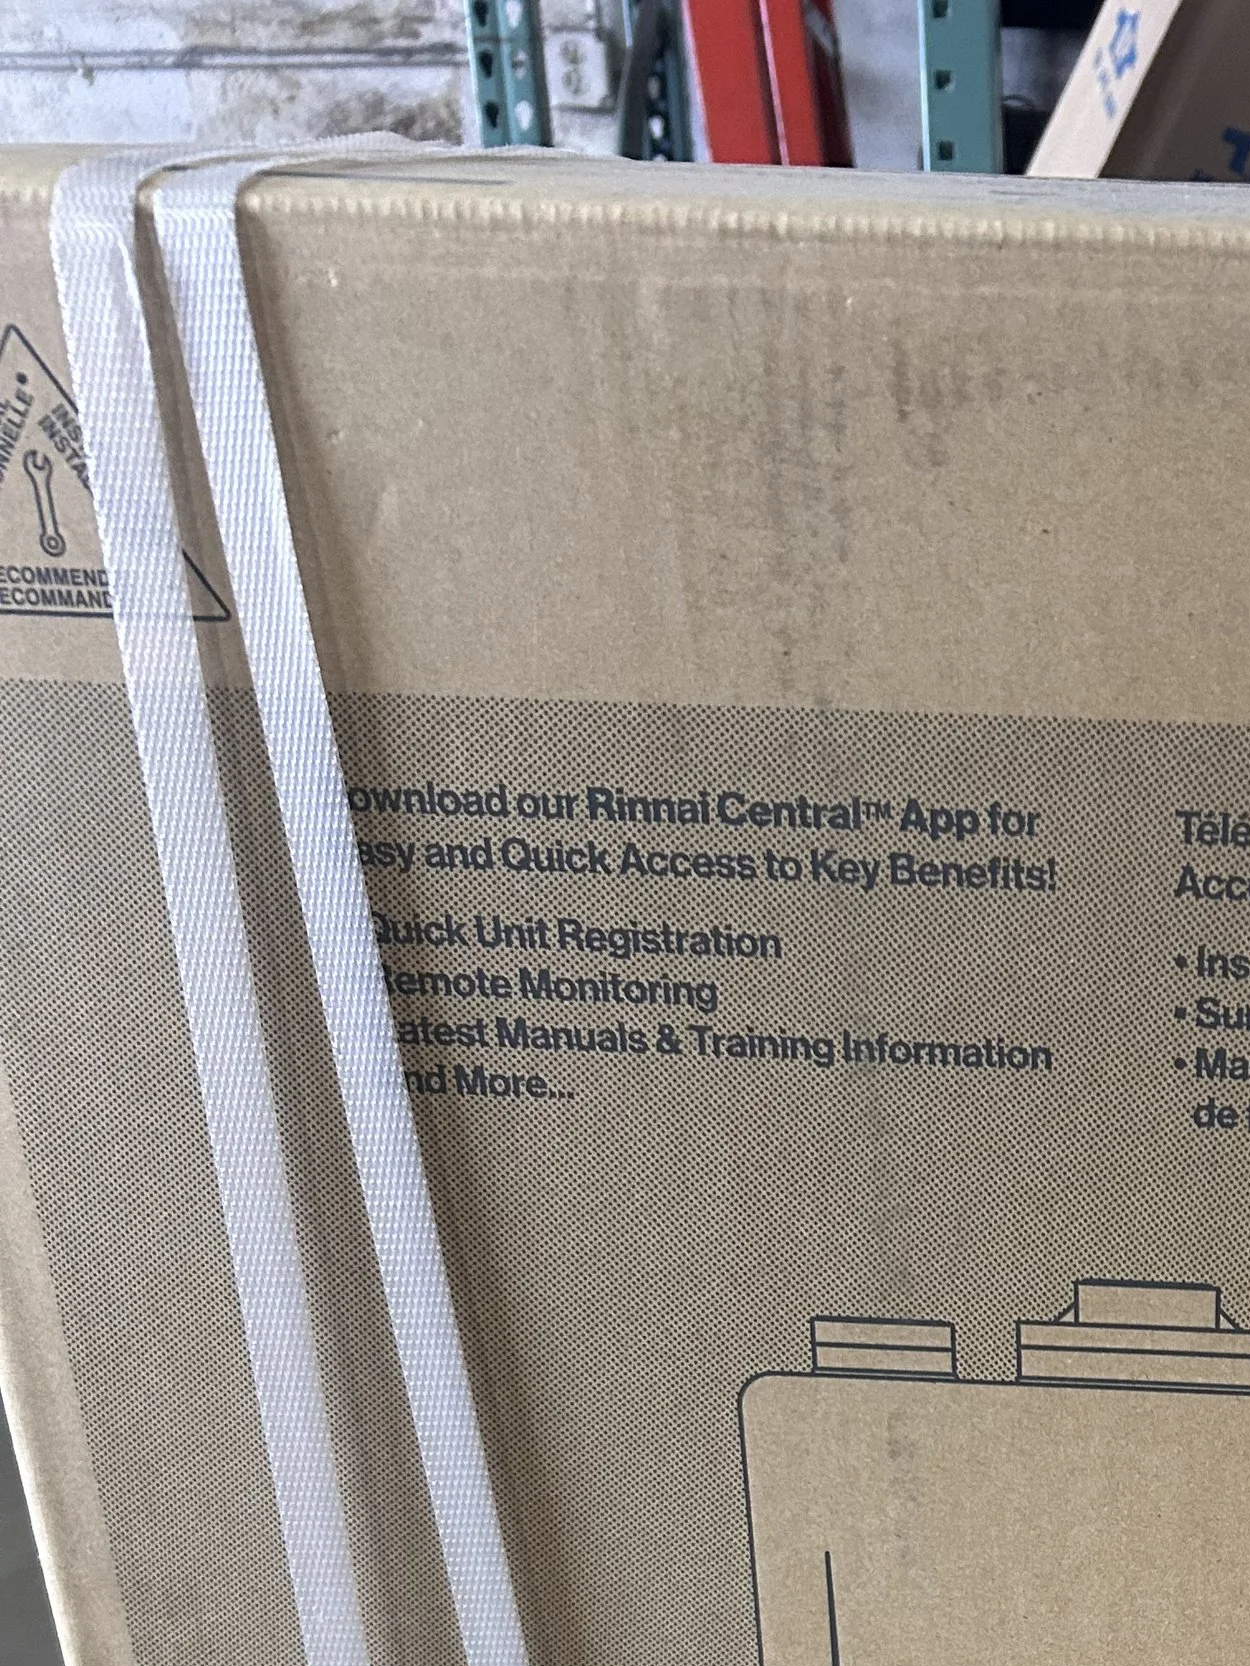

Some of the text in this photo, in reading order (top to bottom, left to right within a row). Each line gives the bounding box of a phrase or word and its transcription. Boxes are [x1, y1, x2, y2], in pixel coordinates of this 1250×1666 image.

[0, 565, 109, 586] ECOMMEND
[0, 586, 113, 609] ECOMMAND
[350, 781, 509, 818] ownload
[517, 792, 575, 819] our
[588, 786, 711, 824] Rinnai
[900, 799, 980, 840] App
[986, 801, 1041, 836] for
[358, 836, 1057, 893] asy and Quick Access to Key Benefits!
[475, 914, 550, 951] Unit
[557, 917, 782, 959] Registration
[518, 966, 719, 1013] Monitoring
[400, 1016, 1053, 1070] atest Manuals & Training Information
[407, 1064, 575, 1100] nd More...
[1192, 1102, 1239, 1131] de
